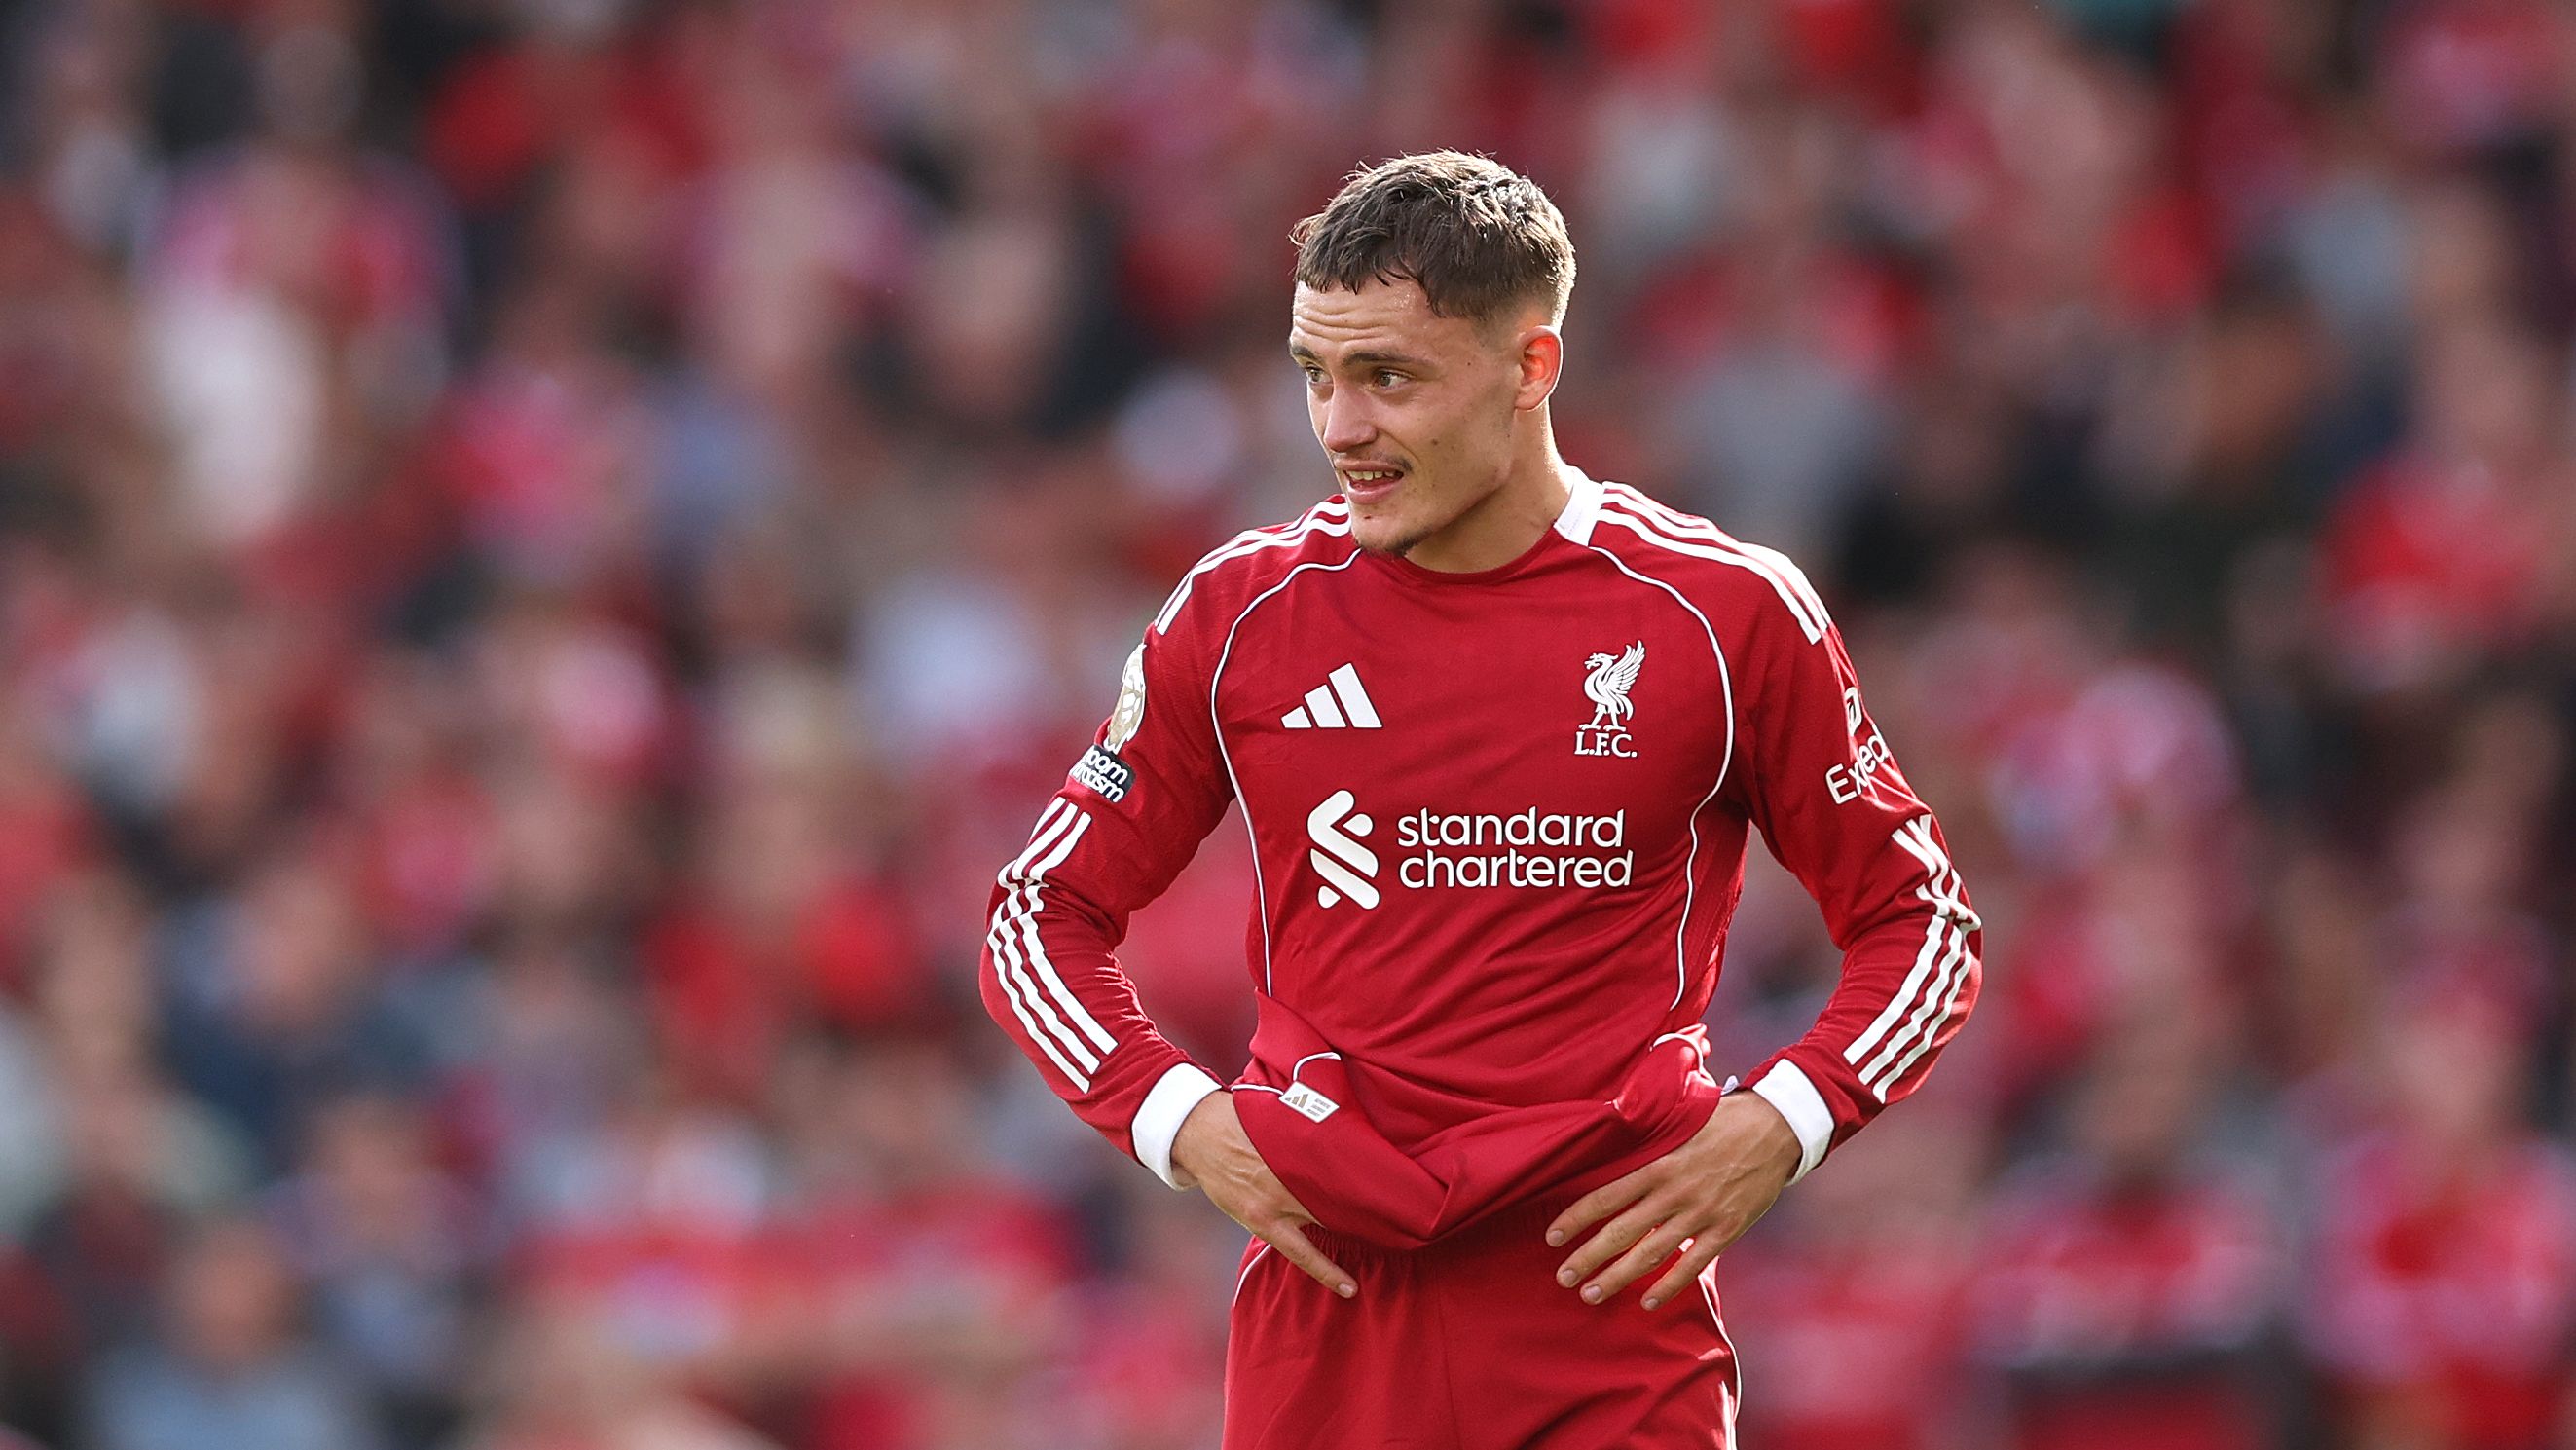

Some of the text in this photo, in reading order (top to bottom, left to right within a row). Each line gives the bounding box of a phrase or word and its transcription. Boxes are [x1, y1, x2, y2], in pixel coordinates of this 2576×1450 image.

[1574, 731, 1638, 758] L.F.C.
[1397, 805, 1625, 848] standard
[1399, 847, 1634, 889] chartered
